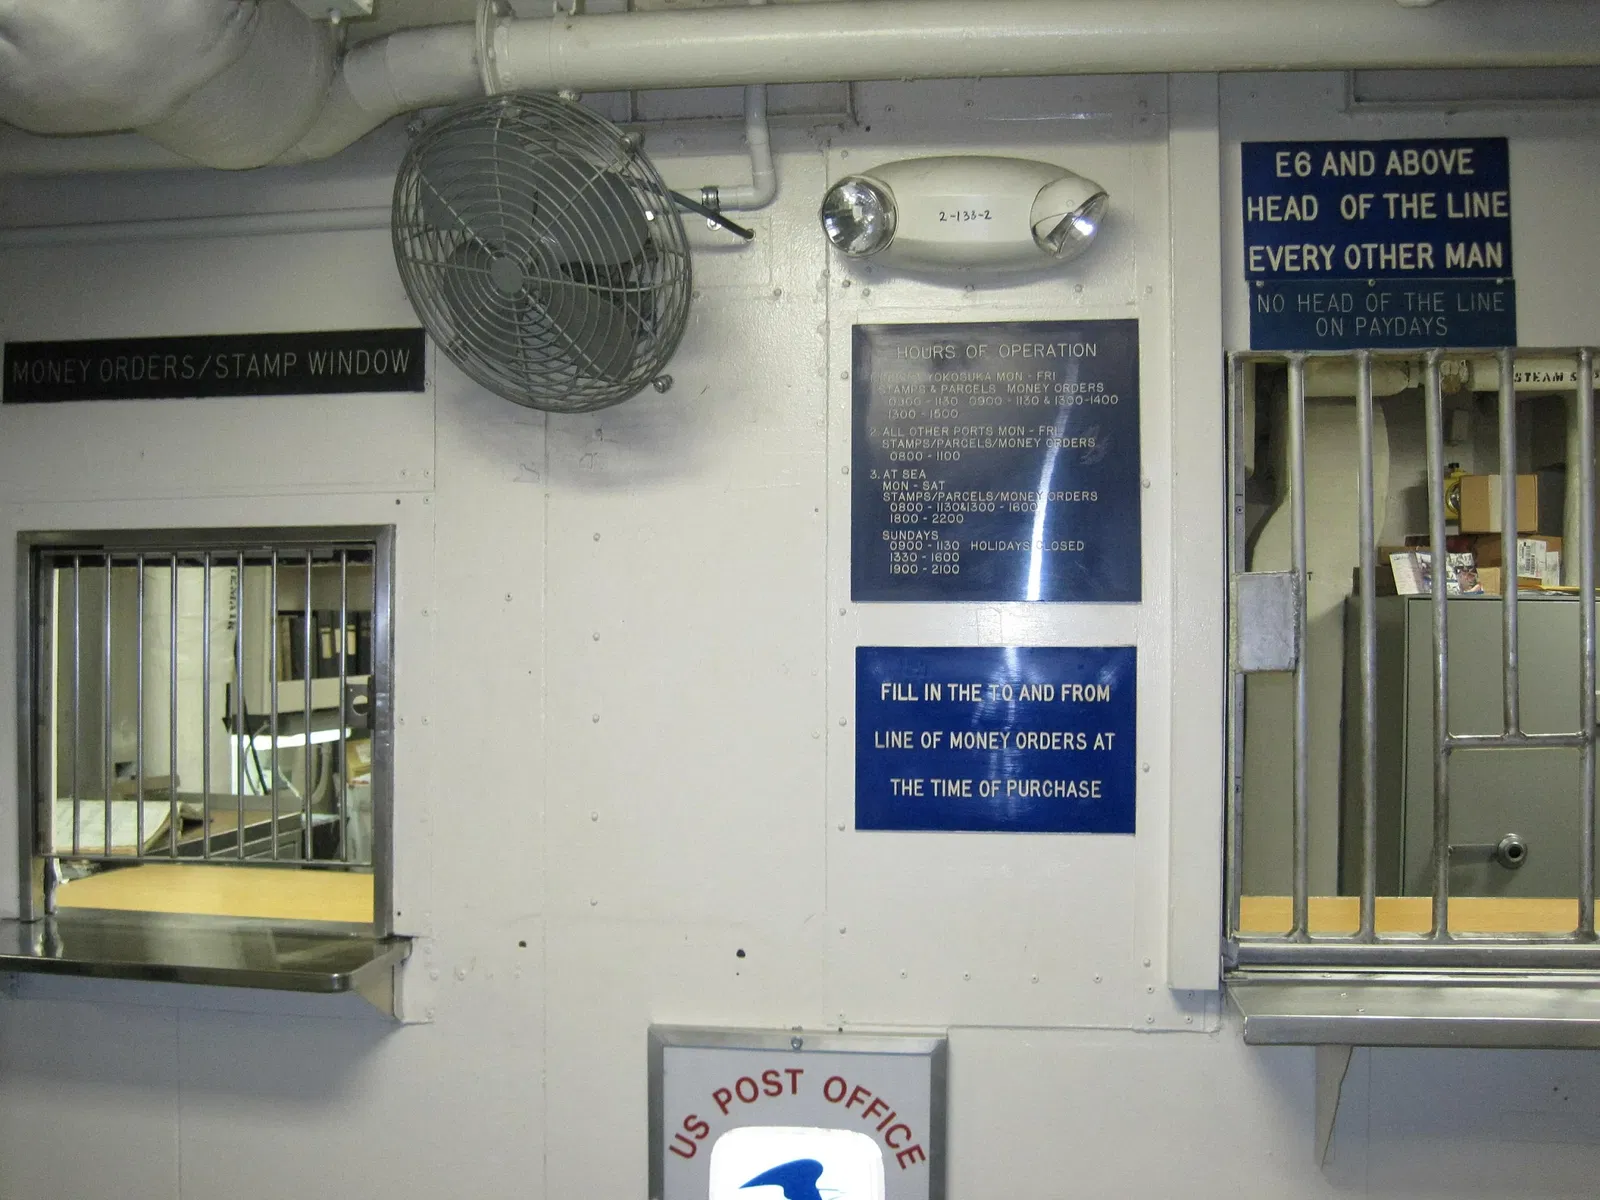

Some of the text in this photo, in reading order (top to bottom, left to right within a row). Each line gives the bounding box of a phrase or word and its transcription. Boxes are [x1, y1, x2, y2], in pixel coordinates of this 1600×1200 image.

[1276, 148, 1474, 178] E6 AND ABOVE
[1248, 190, 1508, 222] HEAD OF THE LINE
[1250, 241, 1503, 271] EVERY OTHER MAN
[1258, 291, 1504, 312] NO HEAD OF THE LINE
[1316, 316, 1447, 336] ON PAYDAYS
[897, 343, 1097, 359] HOURS OF OPERATION
[12, 348, 410, 384] MONEY ORDERS/STAMP WINDOW
[996, 372, 1023, 381] MON
[1037, 371, 1056, 381] FRI
[1514, 372, 1564, 382] STEAM
[941, 384, 996, 394] PARCELS
[1007, 384, 1050, 394] MONEY
[1054, 383, 1104, 393] ORDERS
[935, 396, 958, 406] 1130
[969, 396, 1002, 406] 0900
[1016, 396, 1039, 406] 1130
[1043, 397, 1050, 405] &
[1055, 394, 1119, 406] 1300-1400
[889, 410, 916, 419] 1300
[882, 427, 905, 437] ALL
[909, 427, 949, 437] OTHER
[953, 426, 993, 436] PORTS
[998, 426, 1025, 436] MON
[1038, 426, 1057, 436] FRI
[882, 438, 1096, 449] STAMPS/PARCELS/MONEY ORDERS
[889, 451, 922, 461] 0800
[936, 451, 960, 461] 1100
[870, 469, 927, 479] 3. AT SEA
[882, 481, 909, 491] MON
[922, 481, 945, 490] SAT
[883, 491, 1098, 502] STAMPS/PARCELS/MONEY ORDERS
[890, 502, 923, 512] 0800
[1009, 502, 1038, 512] 1600
[890, 514, 919, 523] 1800
[932, 514, 964, 523] 2200
[882, 530, 939, 540] SUNDAYS
[889, 541, 923, 551] 0900
[936, 541, 960, 551] 1130
[970, 541, 1030, 551] HOLIDAYS
[1036, 541, 1084, 551] CLOSED
[890, 552, 918, 562] 1330
[931, 552, 960, 562] 1600
[890, 564, 918, 574] 1900
[931, 564, 960, 574] 2100
[881, 683, 1110, 702] FILL IN THE TO AND FROM
[874, 731, 1116, 750] LINE OF MONEY ORDERS AT
[890, 778, 1102, 798] THE TIME OF PURCHASE
[669, 1068, 926, 1170] US POST OFFICE
